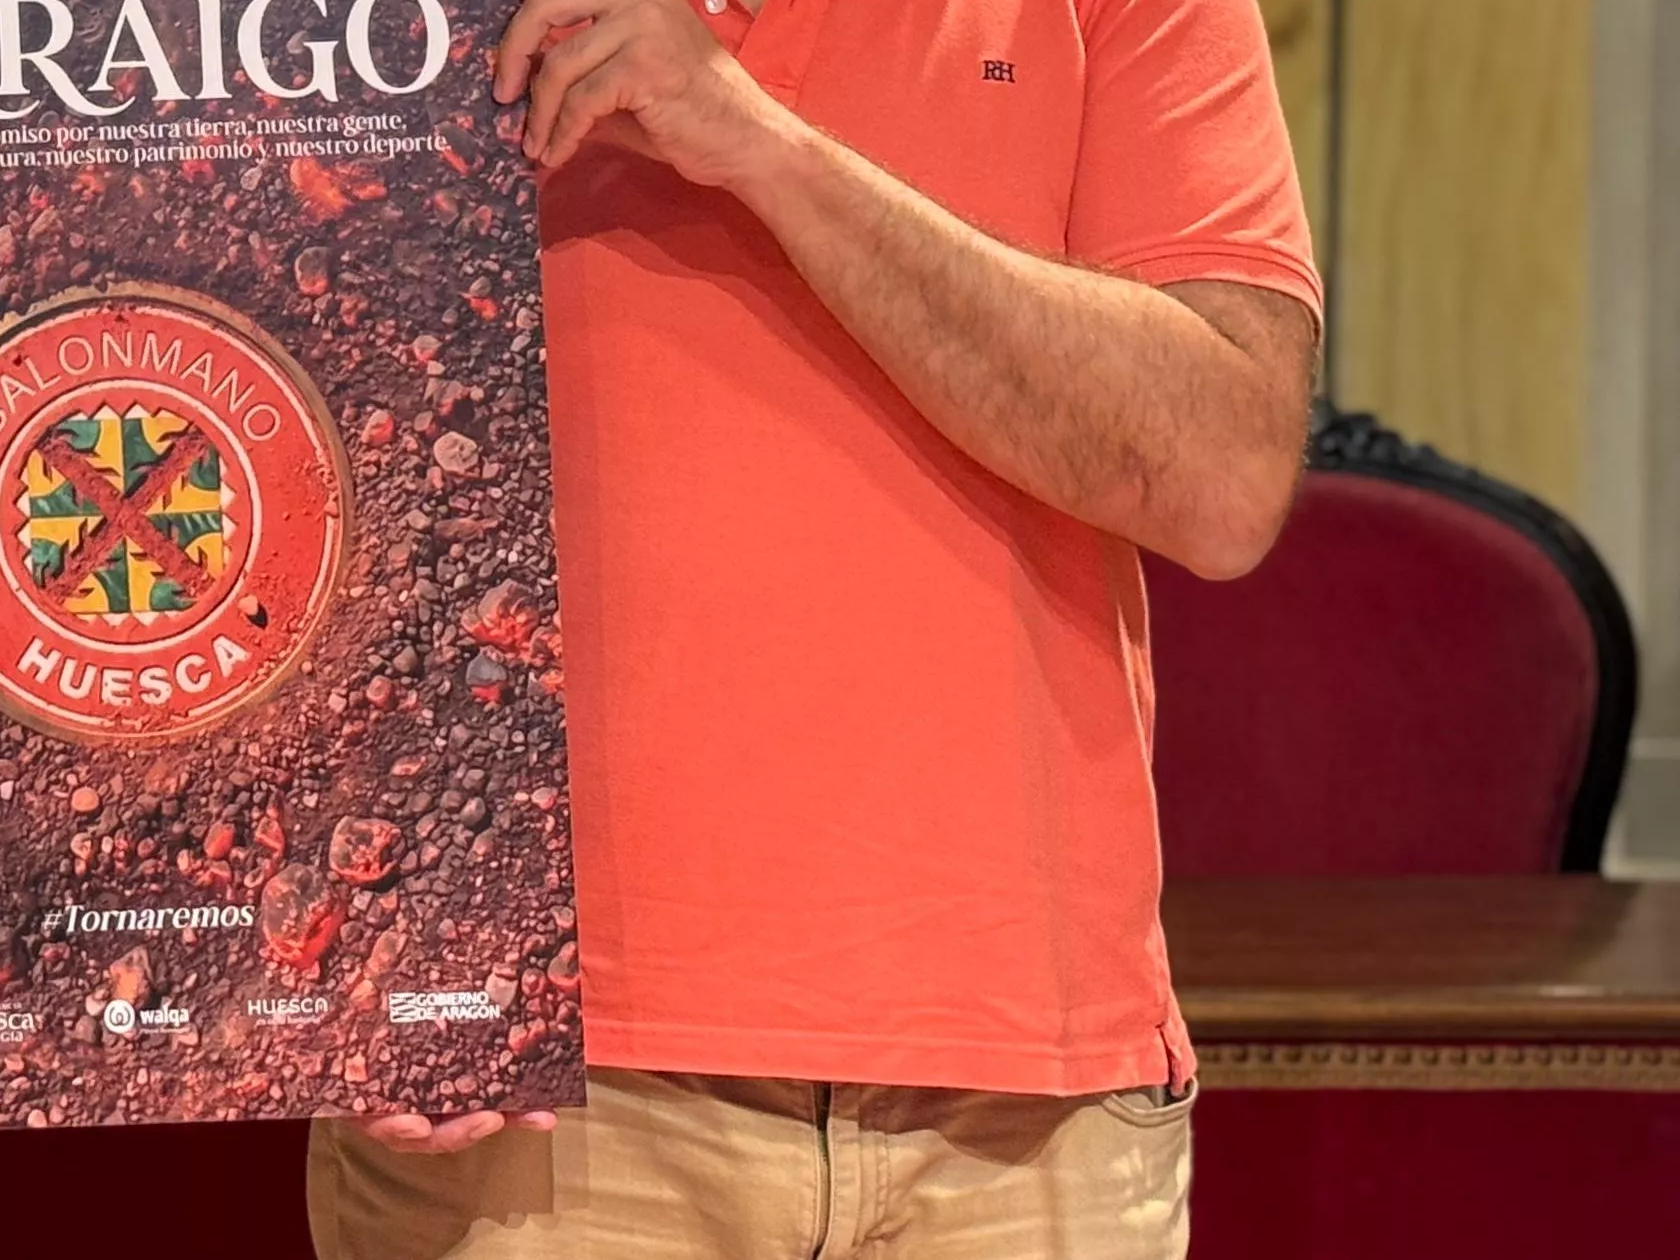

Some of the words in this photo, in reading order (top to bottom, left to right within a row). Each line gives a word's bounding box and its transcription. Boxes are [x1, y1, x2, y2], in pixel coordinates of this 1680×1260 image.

[55, 124, 94, 148] por
[98, 121, 180, 141] nuestra
[185, 117, 255, 138] tierra,
[256, 115, 339, 134] nuestra
[45, 145, 129, 167] nuestro
[133, 139, 253, 167] patrimonio
[254, 141, 270, 165] y
[275, 135, 360, 157] nuestro
[15, 632, 253, 707] HUESCA
[41, 903, 257, 934] #Tornaremos
[247, 997, 329, 1016] HUESCA
[416, 990, 490, 1007] GOBIERNO
[139, 1004, 191, 1027] walqa
[416, 1006, 438, 1021] DE
